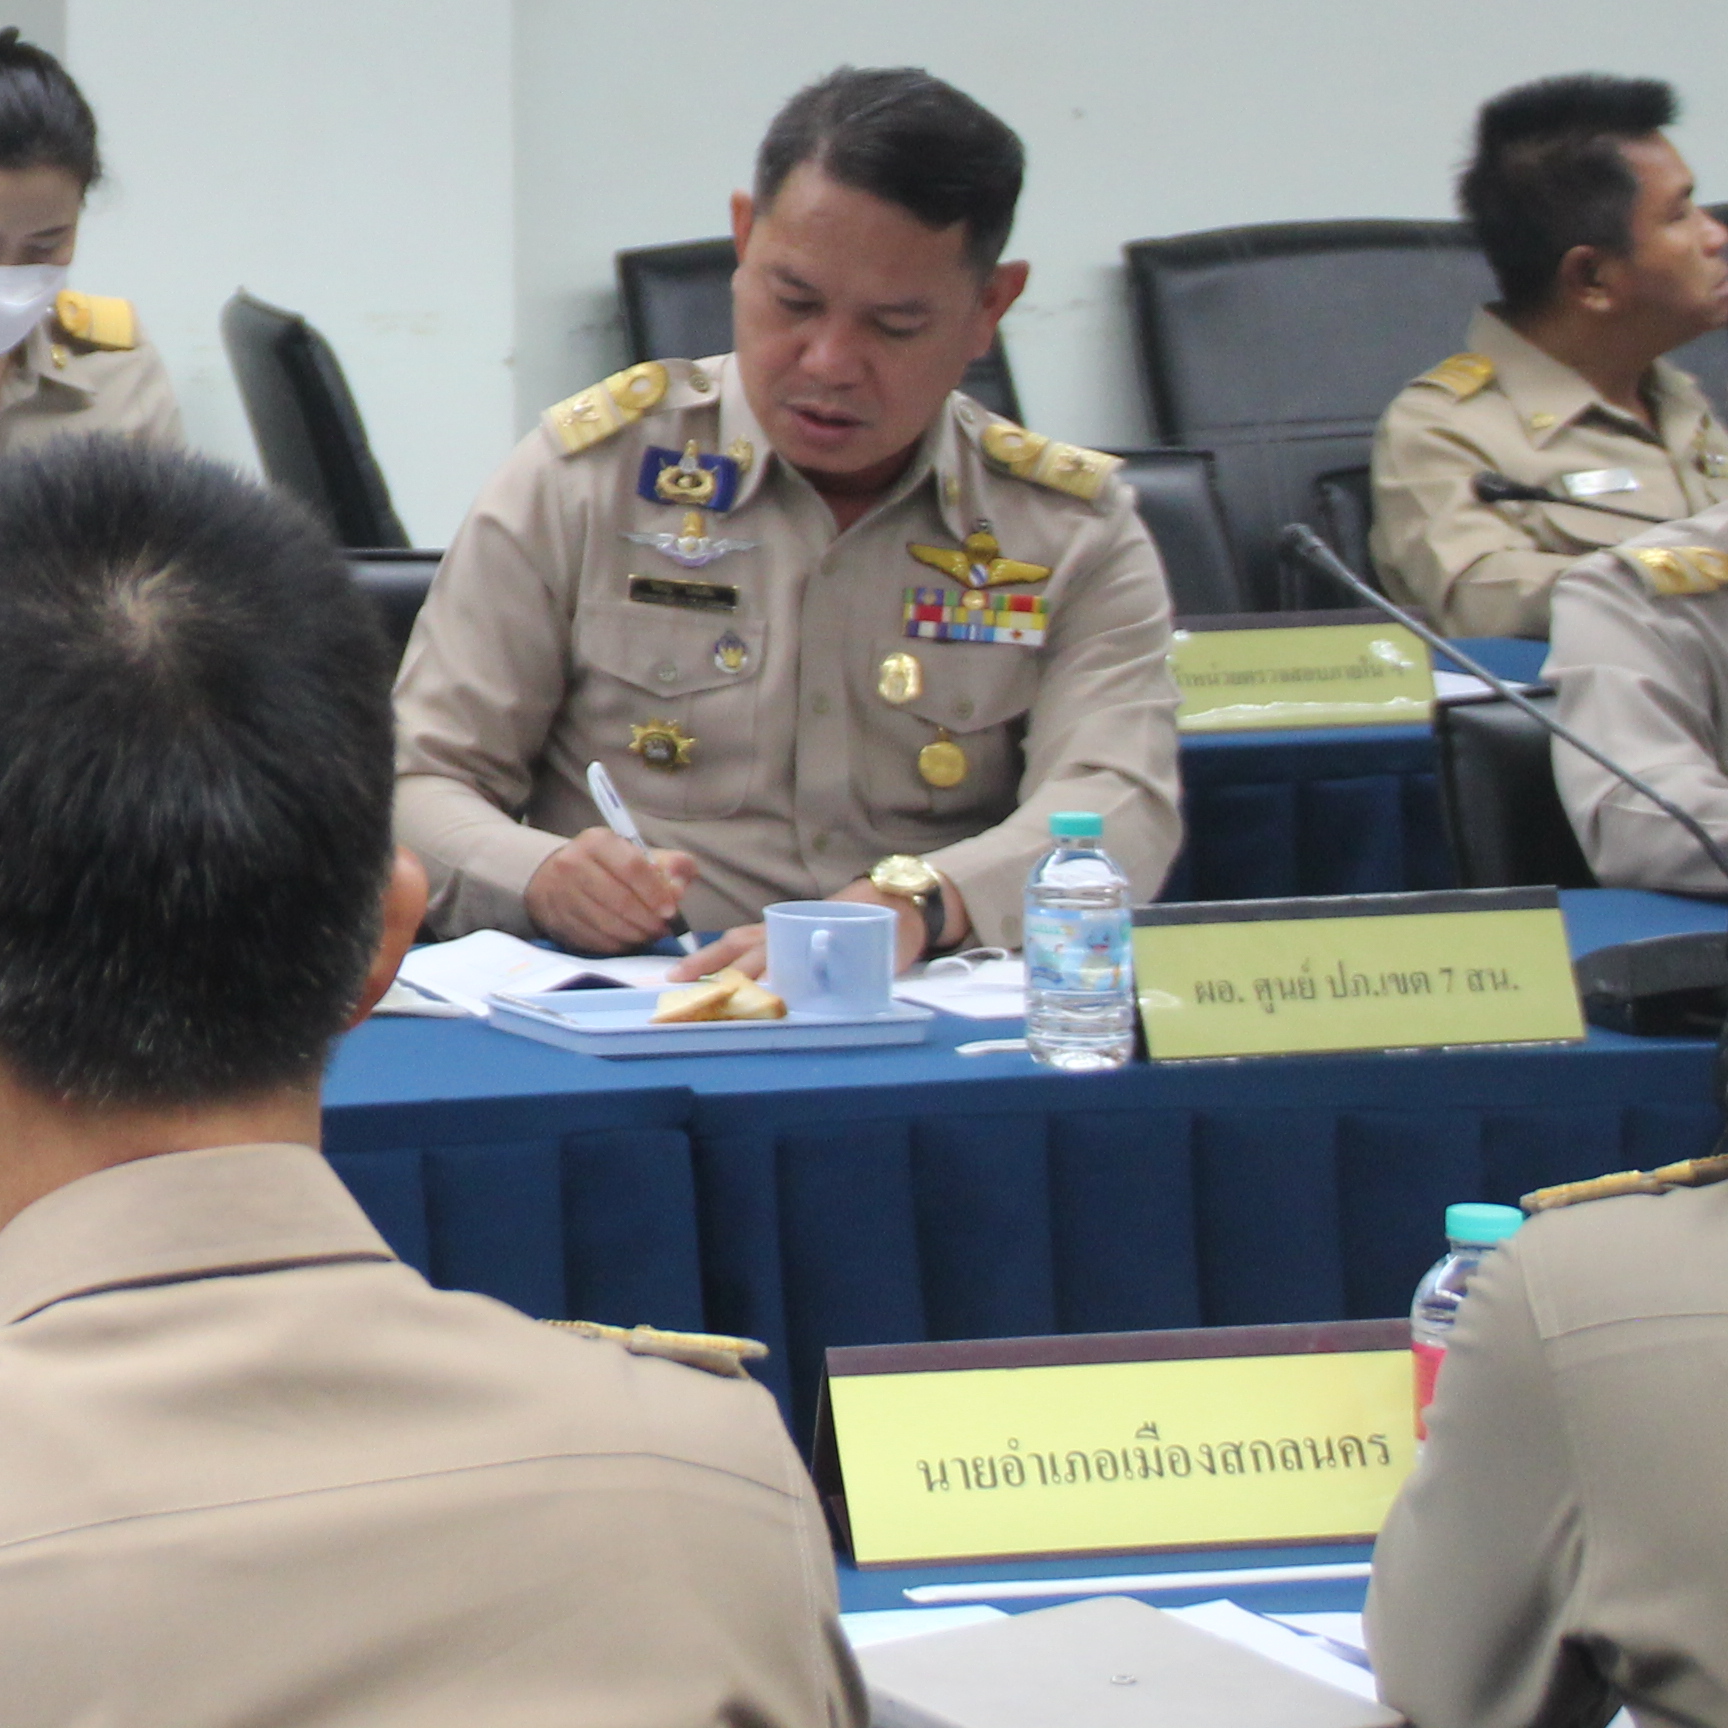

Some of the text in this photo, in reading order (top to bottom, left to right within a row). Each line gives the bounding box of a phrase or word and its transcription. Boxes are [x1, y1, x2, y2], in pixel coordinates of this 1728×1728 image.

[1194, 978, 1245, 1004] ผอ.
[1253, 958, 1316, 1015] ศูนย์
[1439, 967, 1454, 994] 7
[916, 1420, 1393, 1494] นายอำเภอเมืองสกลนคร
